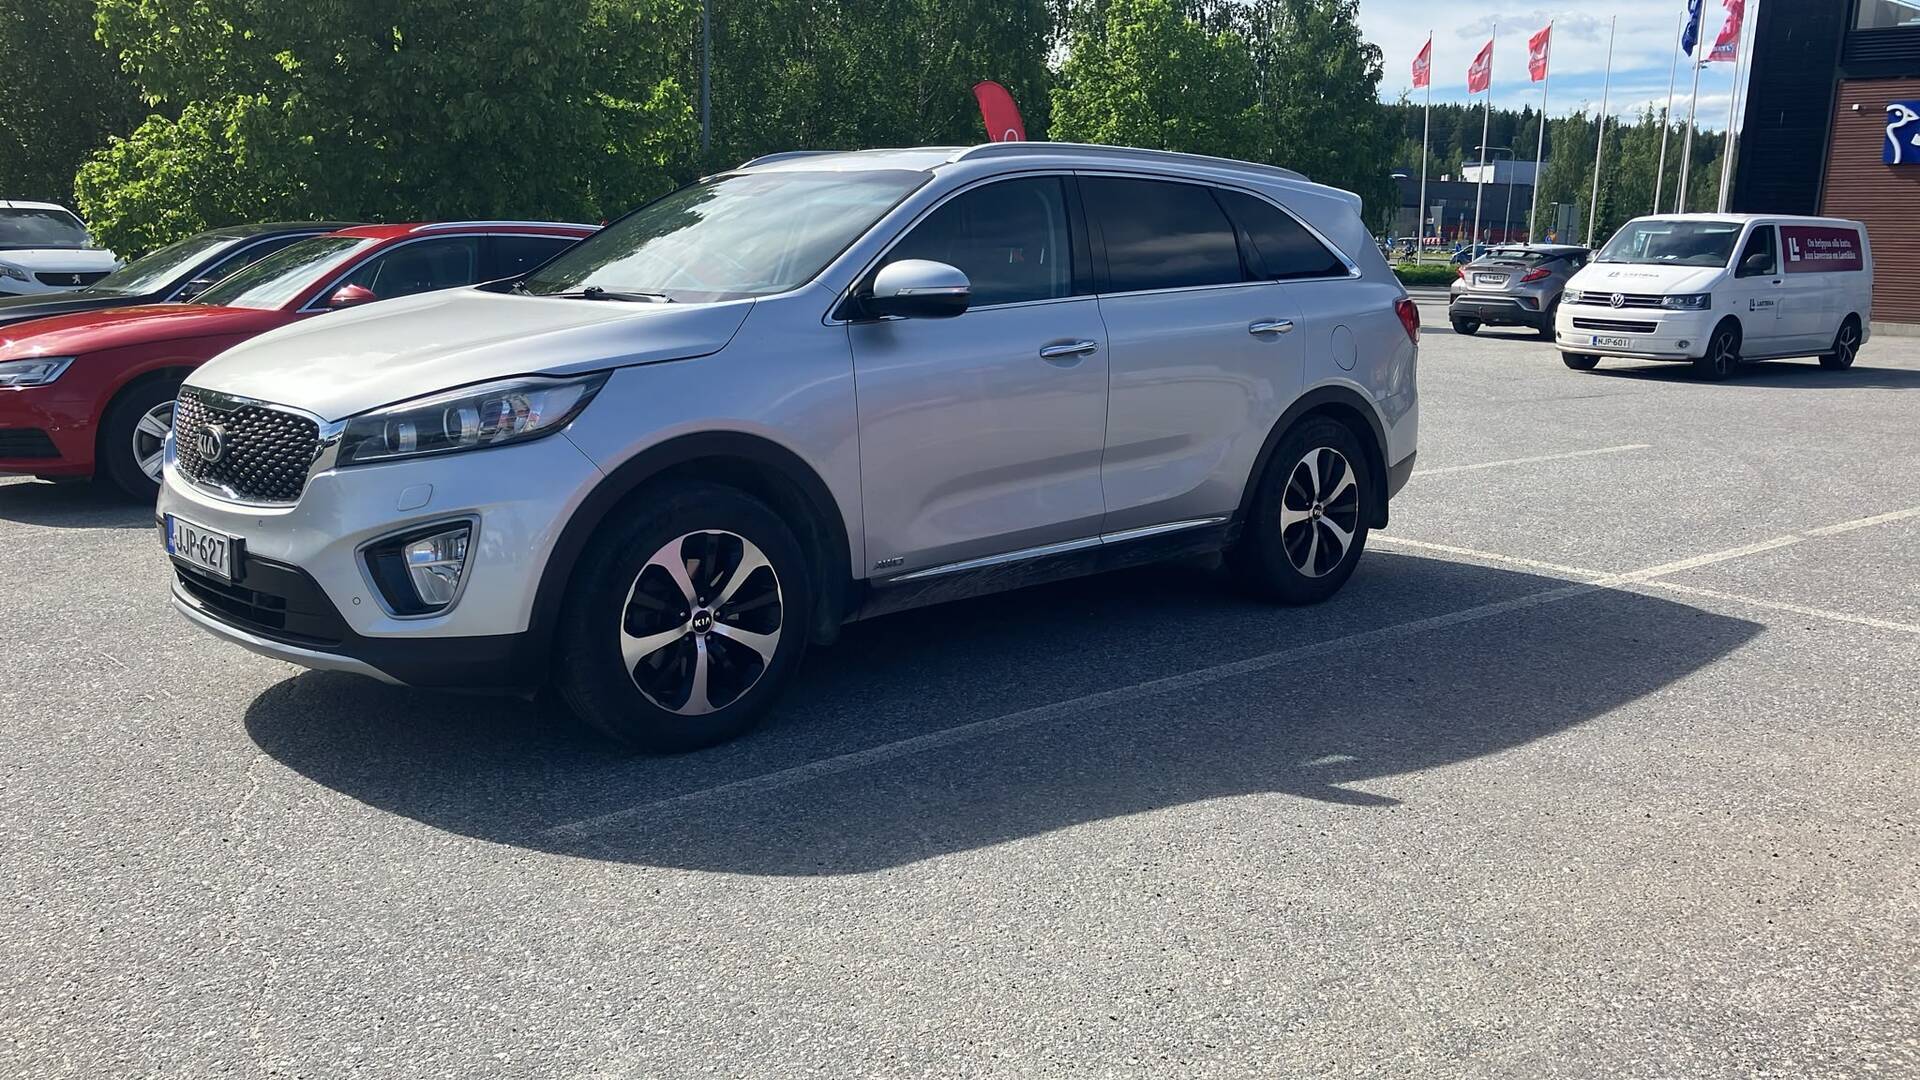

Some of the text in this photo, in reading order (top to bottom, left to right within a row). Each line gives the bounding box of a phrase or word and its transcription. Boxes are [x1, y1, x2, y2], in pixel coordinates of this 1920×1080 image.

[197, 433, 216, 455] KIA
[175, 525, 225, 569] JJP-627
[694, 616, 711, 627] KIA
